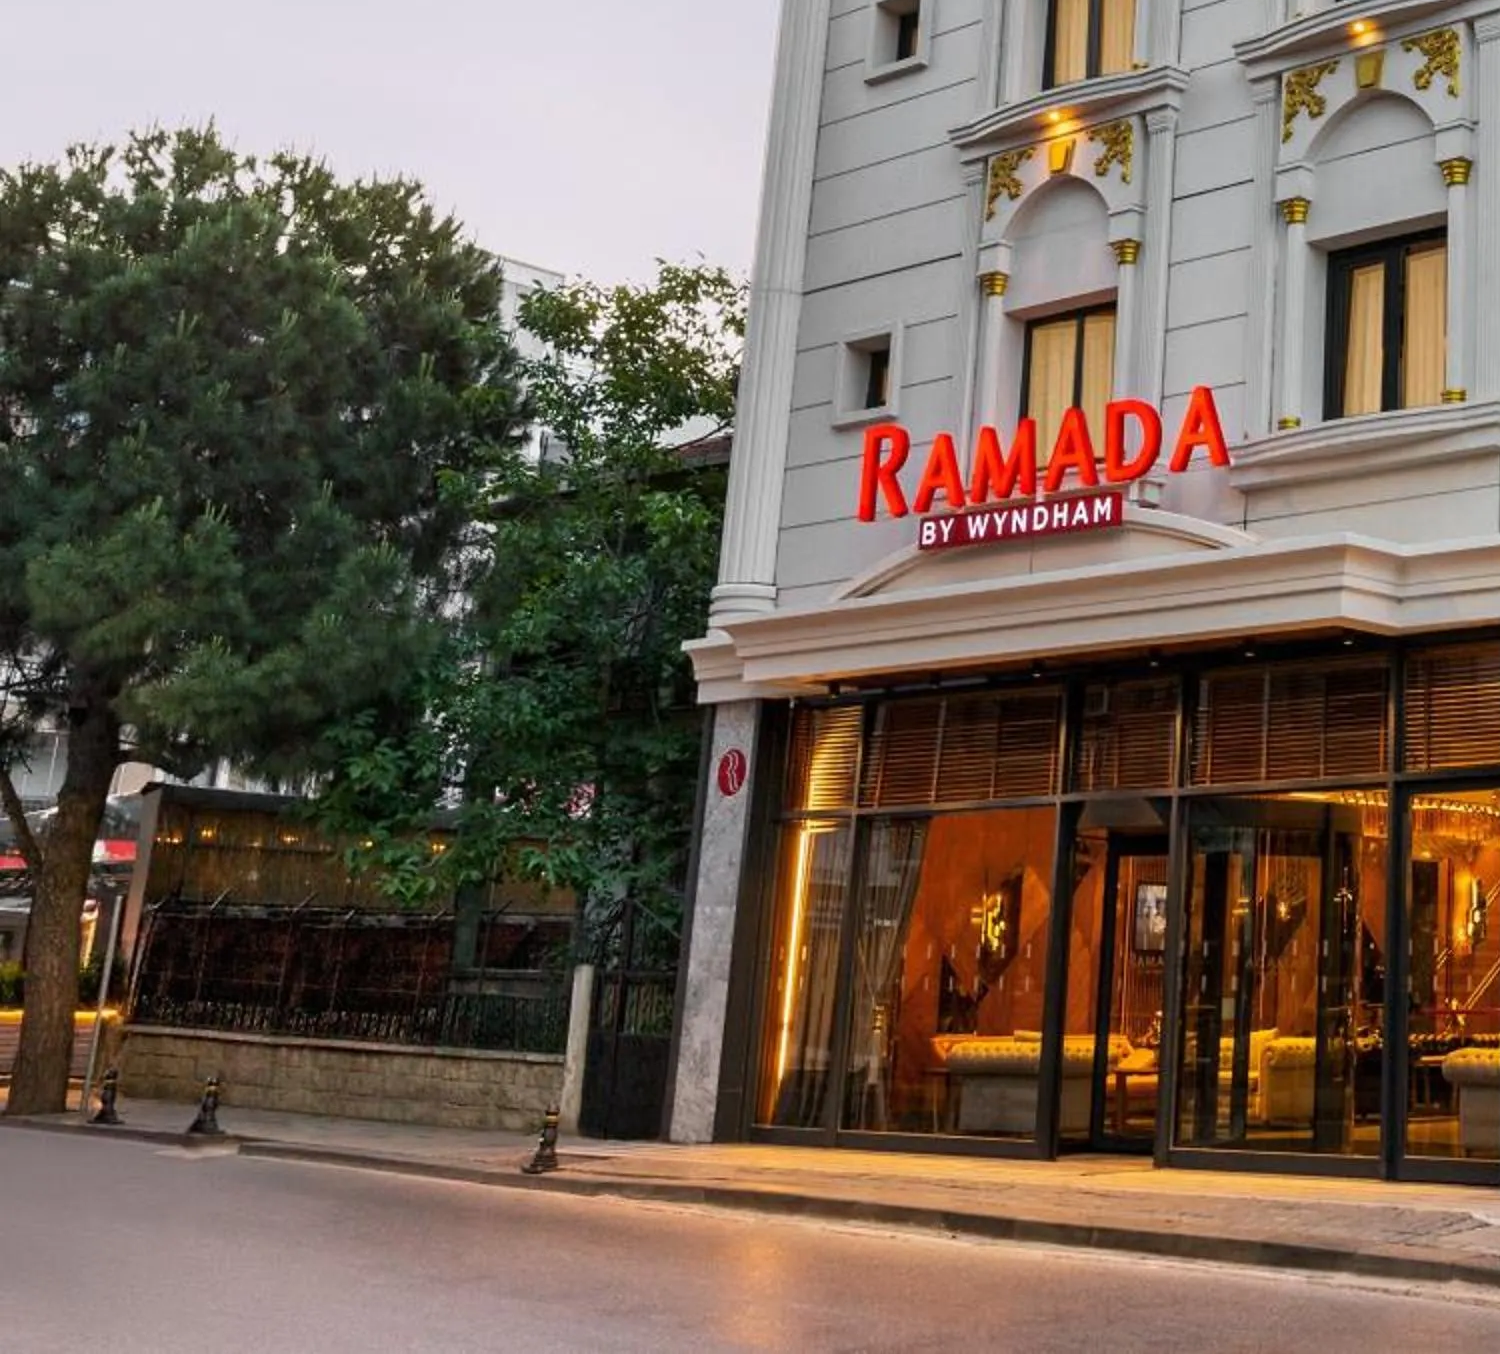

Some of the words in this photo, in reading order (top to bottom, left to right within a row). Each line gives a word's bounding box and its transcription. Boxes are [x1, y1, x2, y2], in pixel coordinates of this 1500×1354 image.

[857, 384, 1231, 522] RAMADA
[921, 517, 955, 545] BY
[967, 496, 1113, 539] WYNDHAM
